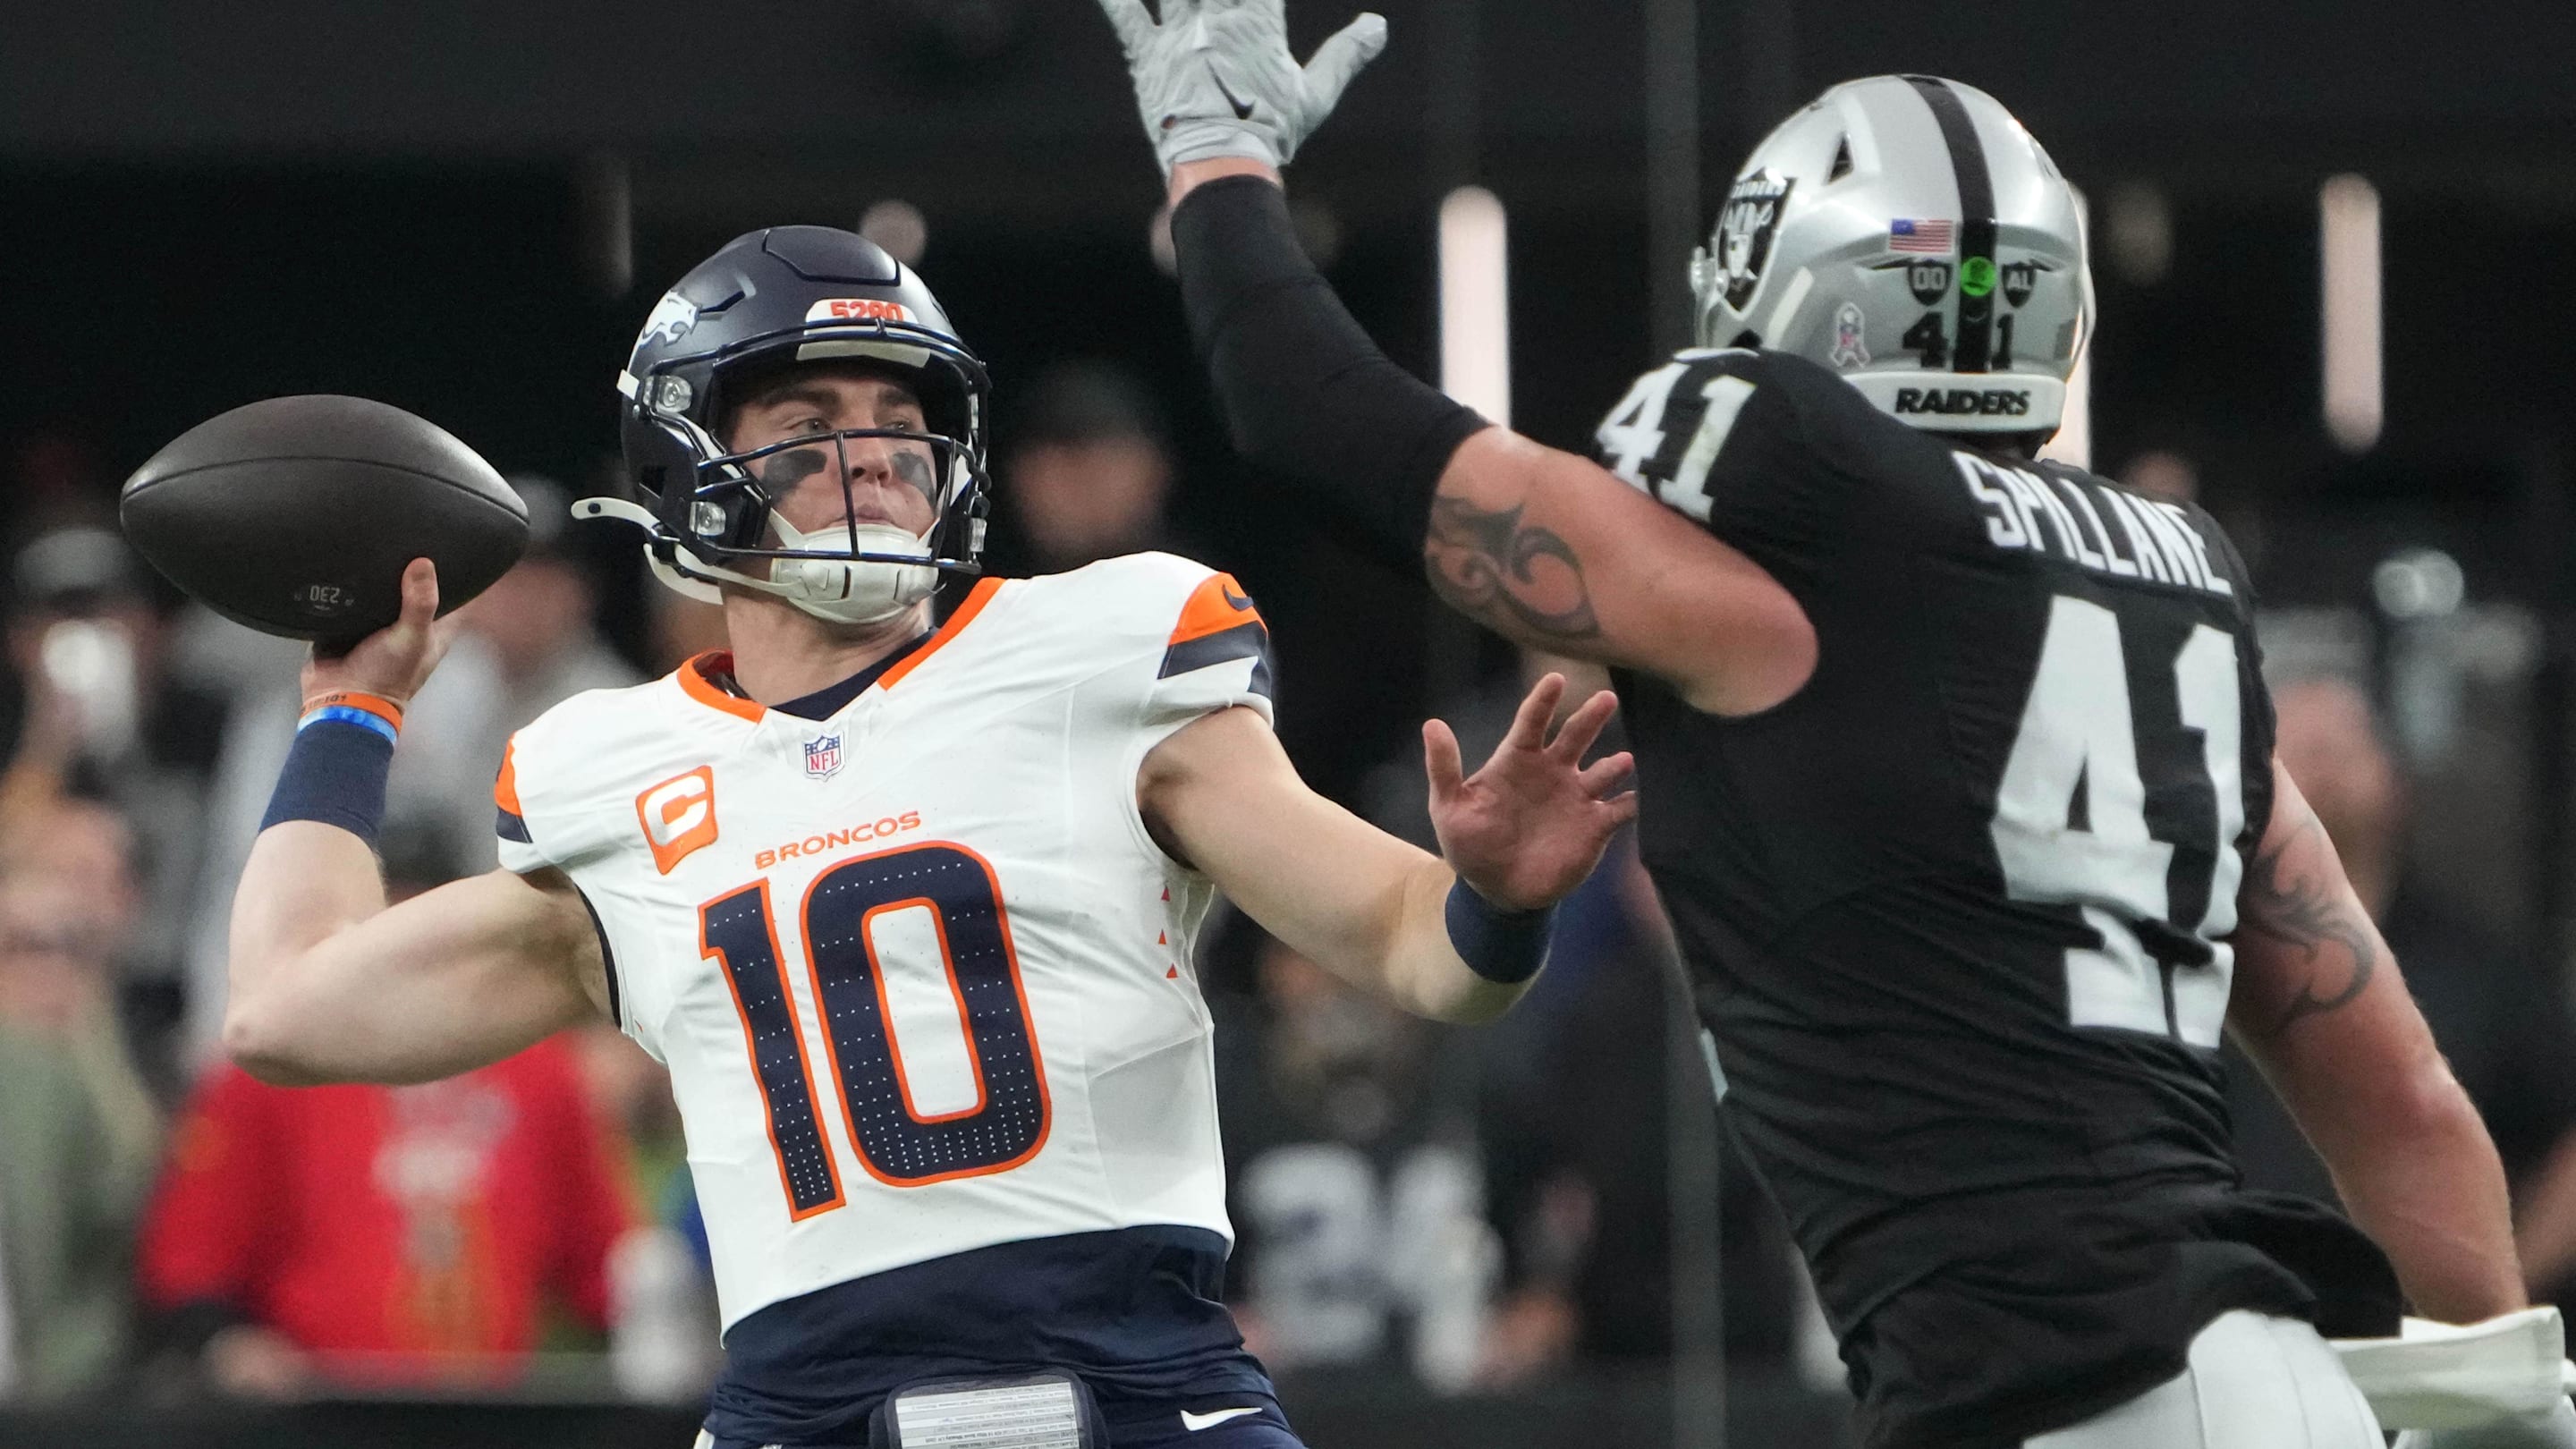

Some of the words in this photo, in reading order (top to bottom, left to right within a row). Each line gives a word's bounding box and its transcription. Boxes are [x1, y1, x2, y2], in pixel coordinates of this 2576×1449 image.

[2006, 268, 2032, 290] AL
[1895, 387, 2031, 416] RAIDERS
[1596, 361, 1758, 523] 41
[1952, 450, 2234, 597] SPILLANE
[309, 584, 341, 605] 230
[809, 749, 839, 771] NFL
[644, 775, 708, 847] C
[755, 810, 921, 870] BRONCOS
[1990, 593, 2244, 1049] 41
[698, 840, 1052, 1223] 10
